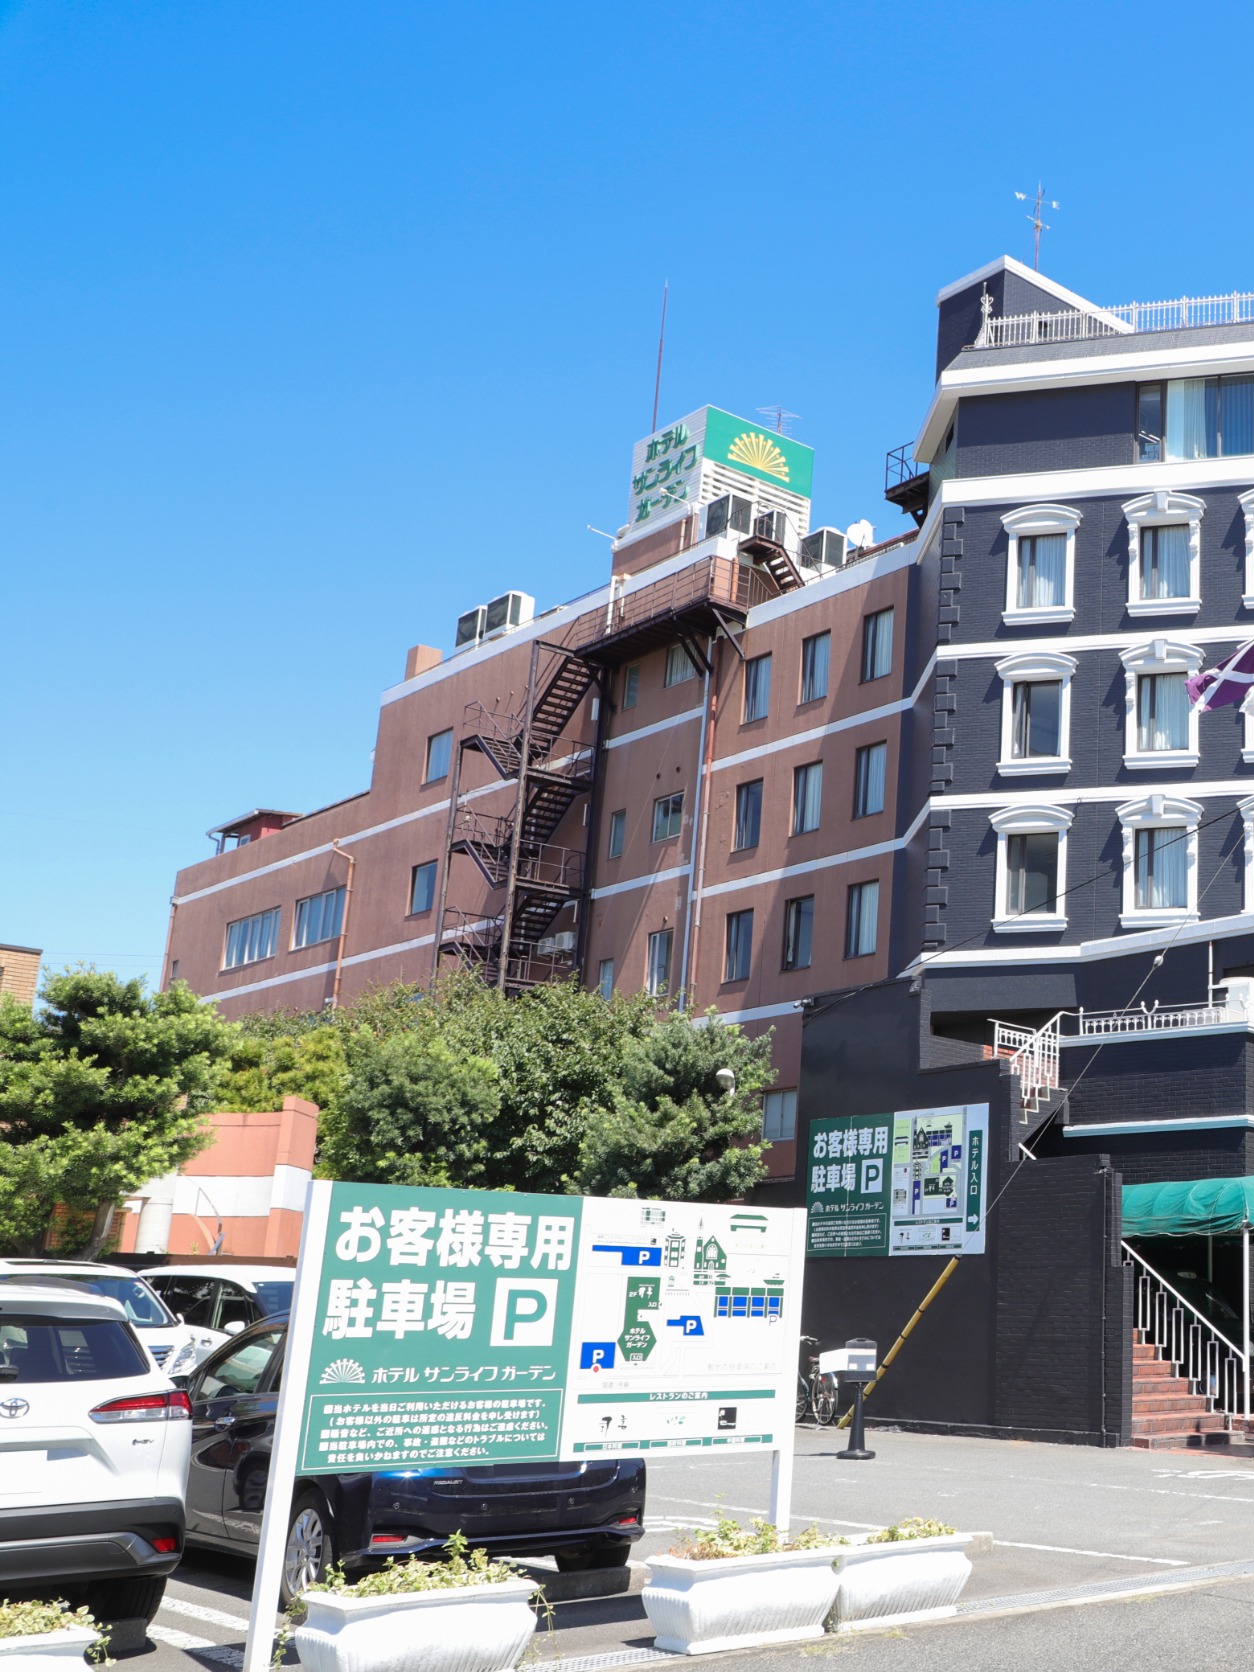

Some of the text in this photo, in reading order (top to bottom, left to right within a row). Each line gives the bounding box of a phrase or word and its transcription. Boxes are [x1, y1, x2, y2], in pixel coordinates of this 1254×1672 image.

[645, 423, 690, 463] ホテル
[632, 443, 700, 496] サンライフ
[635, 479, 690, 523] ガーデン
[813, 1127, 888, 1158] お客様専用
[811, 1163, 880, 1193] 駐車場 P
[970, 1136, 979, 1195] ホテル入口
[825, 1204, 840, 1212] ホテル
[335, 1206, 575, 1271] お客様専用
[639, 1251, 650, 1264] P
[322, 1277, 548, 1340] 駐車場 P
[686, 1320, 697, 1333] P
[593, 1350, 604, 1364] P
[371, 1365, 556, 1384] ホテル サンライフ ガーデン
[650, 1391, 708, 1400] レストランのご案内
